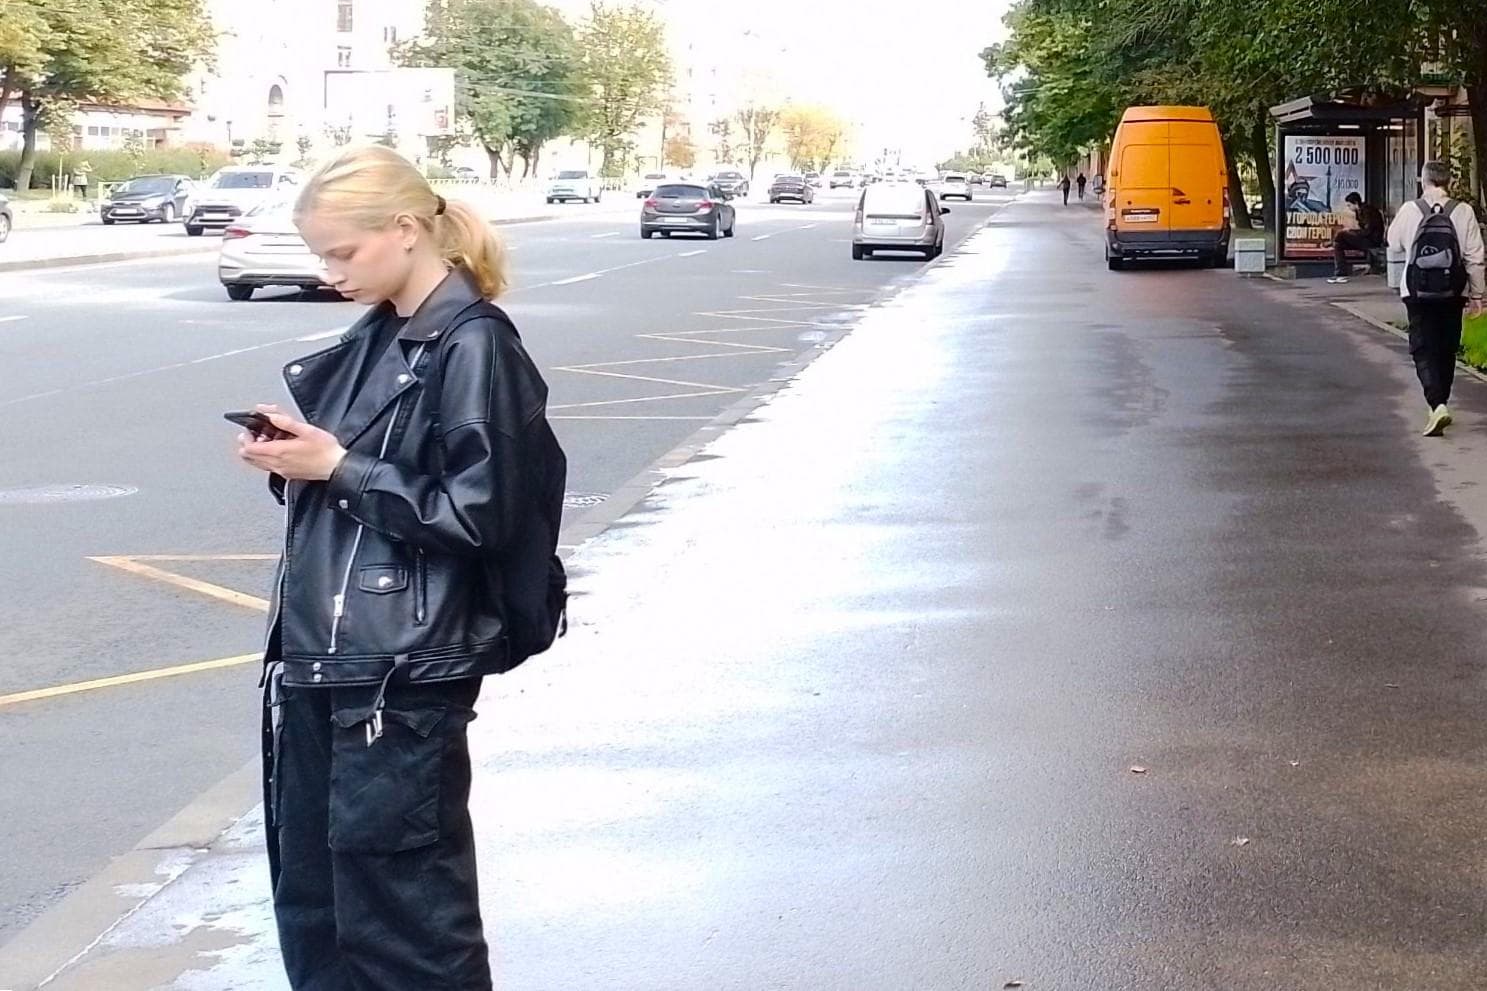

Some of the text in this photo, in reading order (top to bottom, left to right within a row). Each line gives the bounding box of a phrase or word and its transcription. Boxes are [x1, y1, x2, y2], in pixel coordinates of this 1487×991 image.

[1295, 146, 1358, 165] 2 500 000
